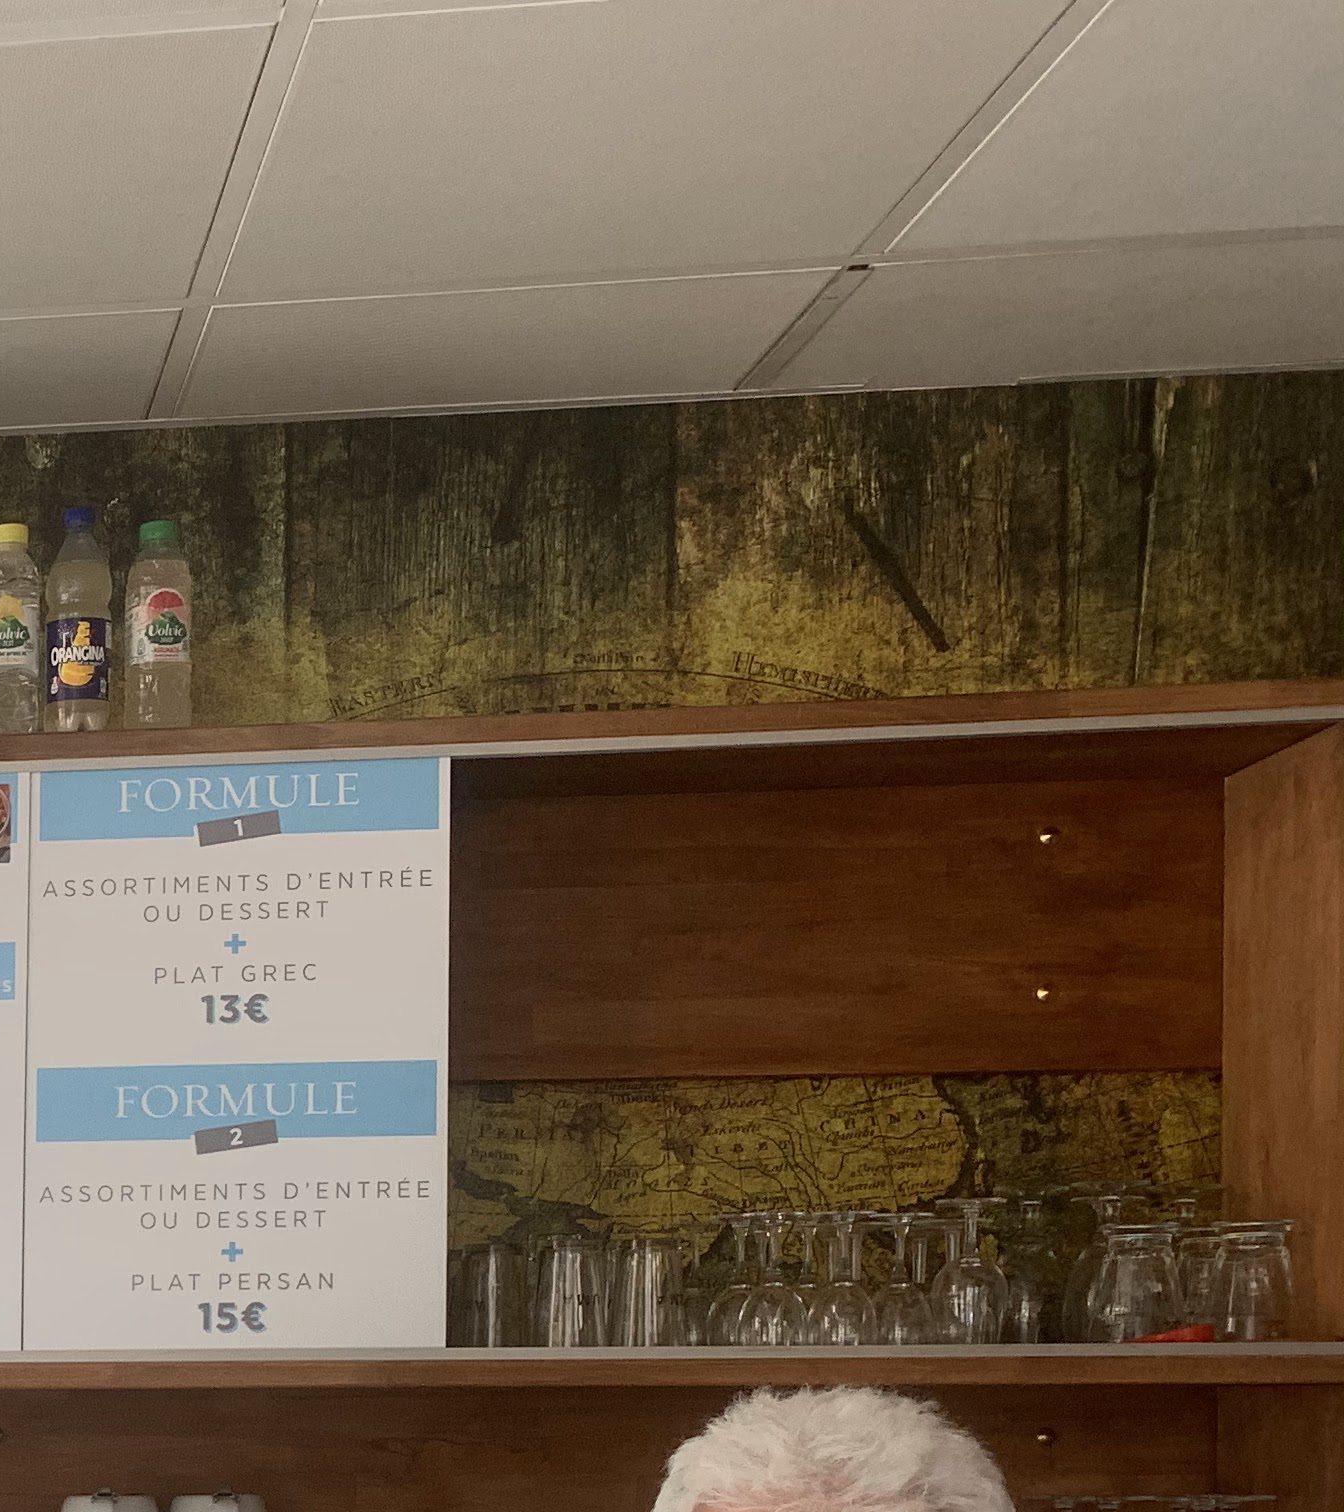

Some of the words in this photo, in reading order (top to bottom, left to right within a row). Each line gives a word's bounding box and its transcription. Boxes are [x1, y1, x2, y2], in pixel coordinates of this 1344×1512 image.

[51, 645, 105, 667] ORANGINA
[117, 772, 360, 813] FORMULE
[233, 819, 244, 837] 1
[43, 875, 269, 898] ASSORTIMENTS
[143, 905, 182, 922] OU
[199, 901, 330, 921] DESSERT
[154, 966, 223, 984] PLAT
[241, 964, 317, 982] GREC
[201, 994, 270, 1024] 13€
[115, 1081, 358, 1119] FORMULE
[230, 1128, 243, 1145] 2
[39, 1183, 266, 1203] ASSORTIMENTS
[140, 1212, 178, 1229] OU
[197, 1210, 327, 1229] DESSERT
[132, 1274, 201, 1292] PLAT
[219, 1273, 335, 1291] PERSAN
[198, 1302, 267, 1333] 15€
